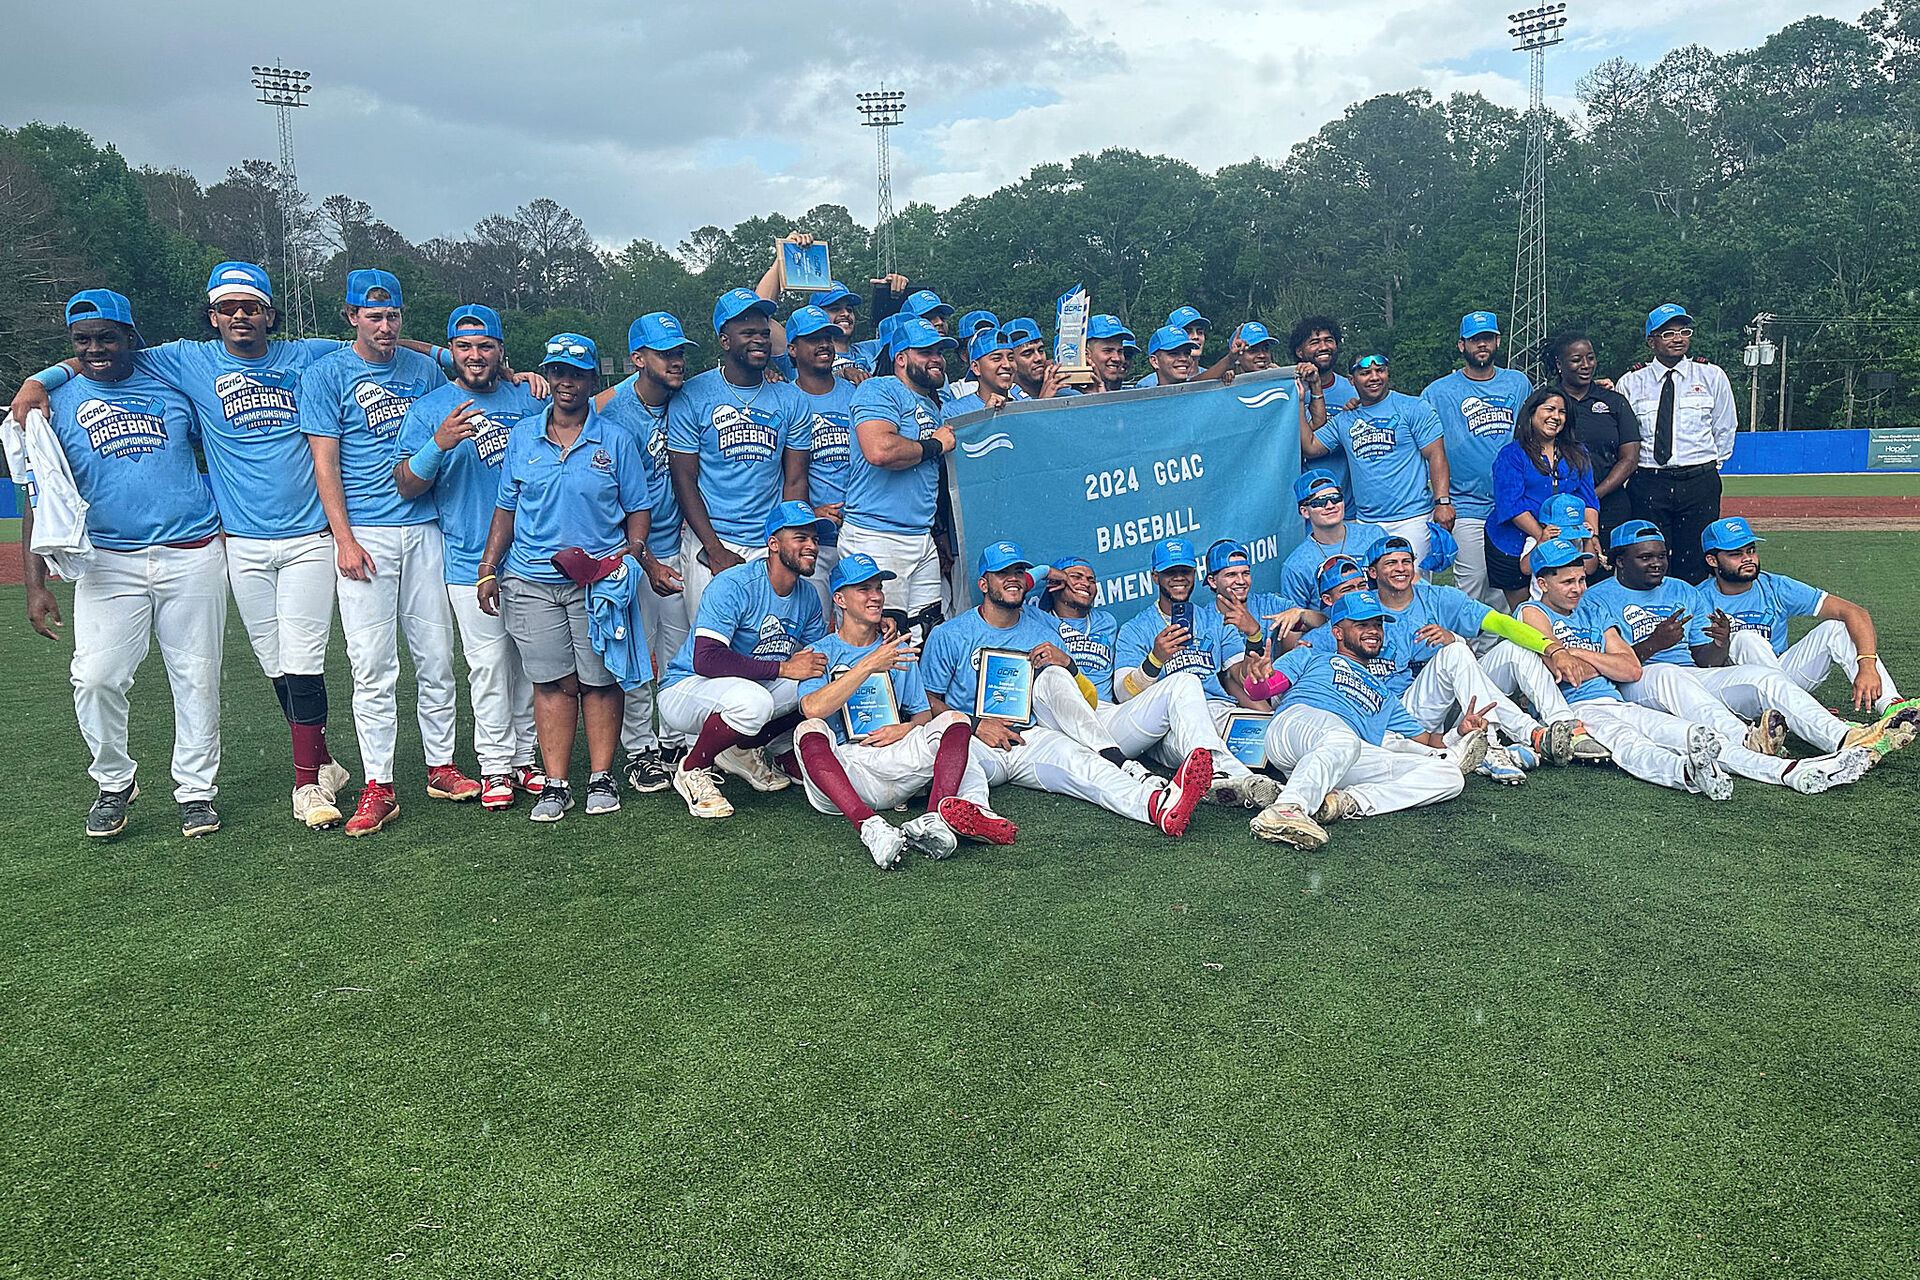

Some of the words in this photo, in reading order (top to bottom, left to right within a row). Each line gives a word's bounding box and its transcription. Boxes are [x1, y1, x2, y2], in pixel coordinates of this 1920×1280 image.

[217, 375, 242, 393] GCAC
[358, 387, 382, 404] GCAC
[80, 404, 107, 424] GCAC
[224, 392, 297, 419] BASEBALL
[233, 410, 291, 426] CHAMPIONSHIP
[714, 411, 738, 425] GCAC
[1468, 411, 1514, 431] BASEBALL
[90, 419, 167, 449] BASEBALL
[720, 429, 777, 450] BASEBALL
[1353, 432, 1396, 451] BASEBALL
[101, 436, 162, 455] CHAMPIONSHIP
[725, 445, 772, 457] CHAMPIONSHIP
[1885, 445, 1906, 454] Hope
[1085, 466, 1140, 501] 2024
[1153, 453, 1204, 486] GCAC
[1096, 507, 1201, 554] BASEBALL
[1625, 609, 1644, 621] GCAC
[997, 668, 1019, 677] GCAC
[1164, 654, 1215, 675] BASEBALL
[855, 687, 877, 695] GCAC
